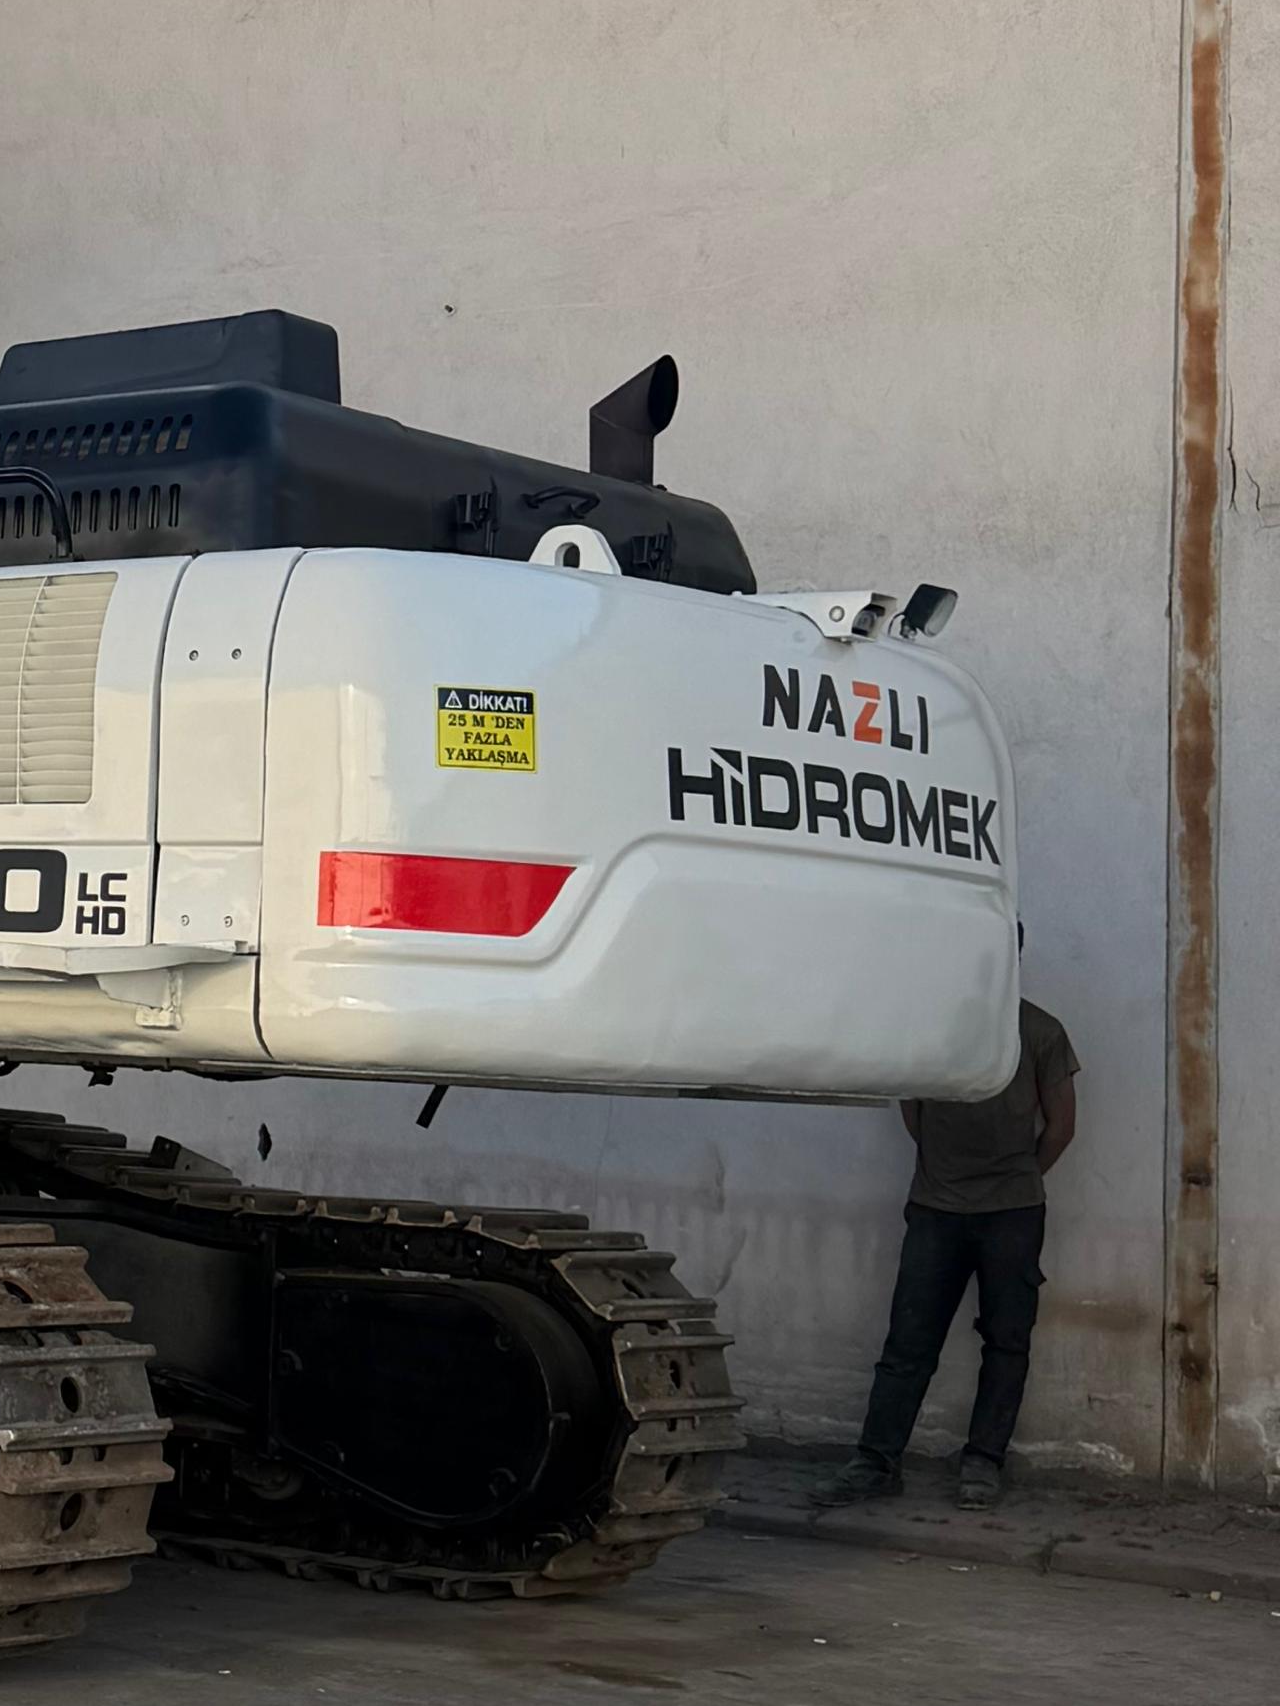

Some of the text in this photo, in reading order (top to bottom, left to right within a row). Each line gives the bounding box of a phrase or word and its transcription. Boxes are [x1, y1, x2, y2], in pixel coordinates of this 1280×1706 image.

[469, 691, 528, 712] DİKKAT!
[762, 663, 928, 754] NAZLI
[448, 713, 467, 726] 25
[472, 714, 485, 727] M
[463, 732, 512, 746] FAZLA
[445, 748, 530, 766] YAKLAŞMA
[78, 873, 127, 901] LC
[75, 906, 126, 935] HD
